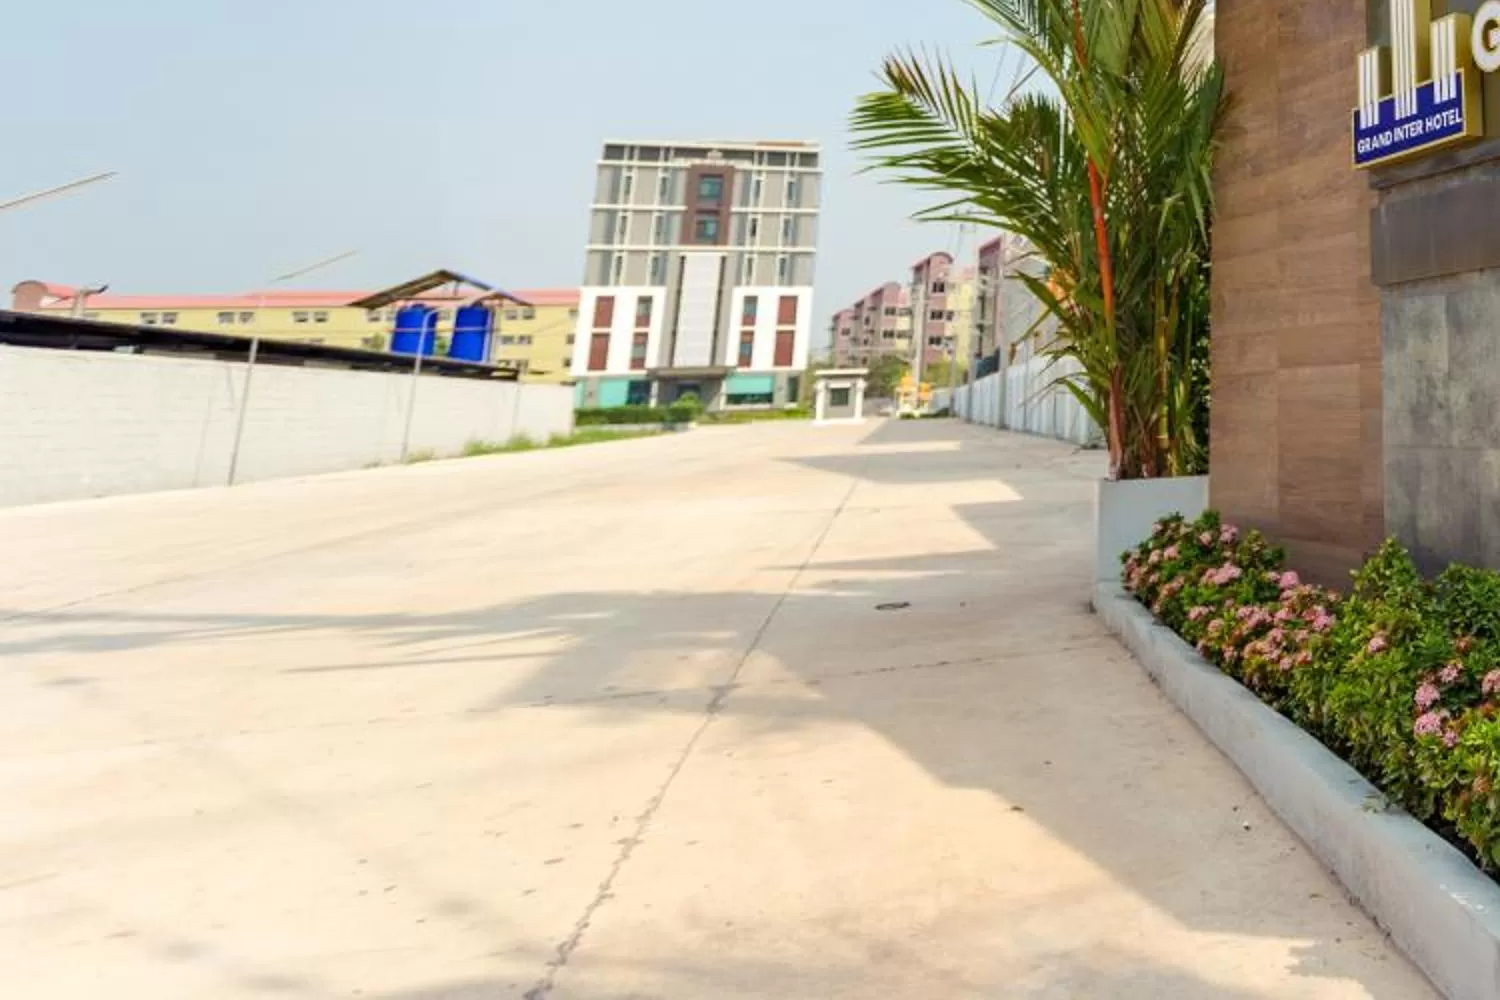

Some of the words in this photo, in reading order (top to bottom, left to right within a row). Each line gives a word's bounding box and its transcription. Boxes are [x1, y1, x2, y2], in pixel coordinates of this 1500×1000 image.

[1357, 131, 1393, 154] GRAND
[1394, 119, 1424, 143] INTER
[1425, 107, 1463, 133] HOTEL
